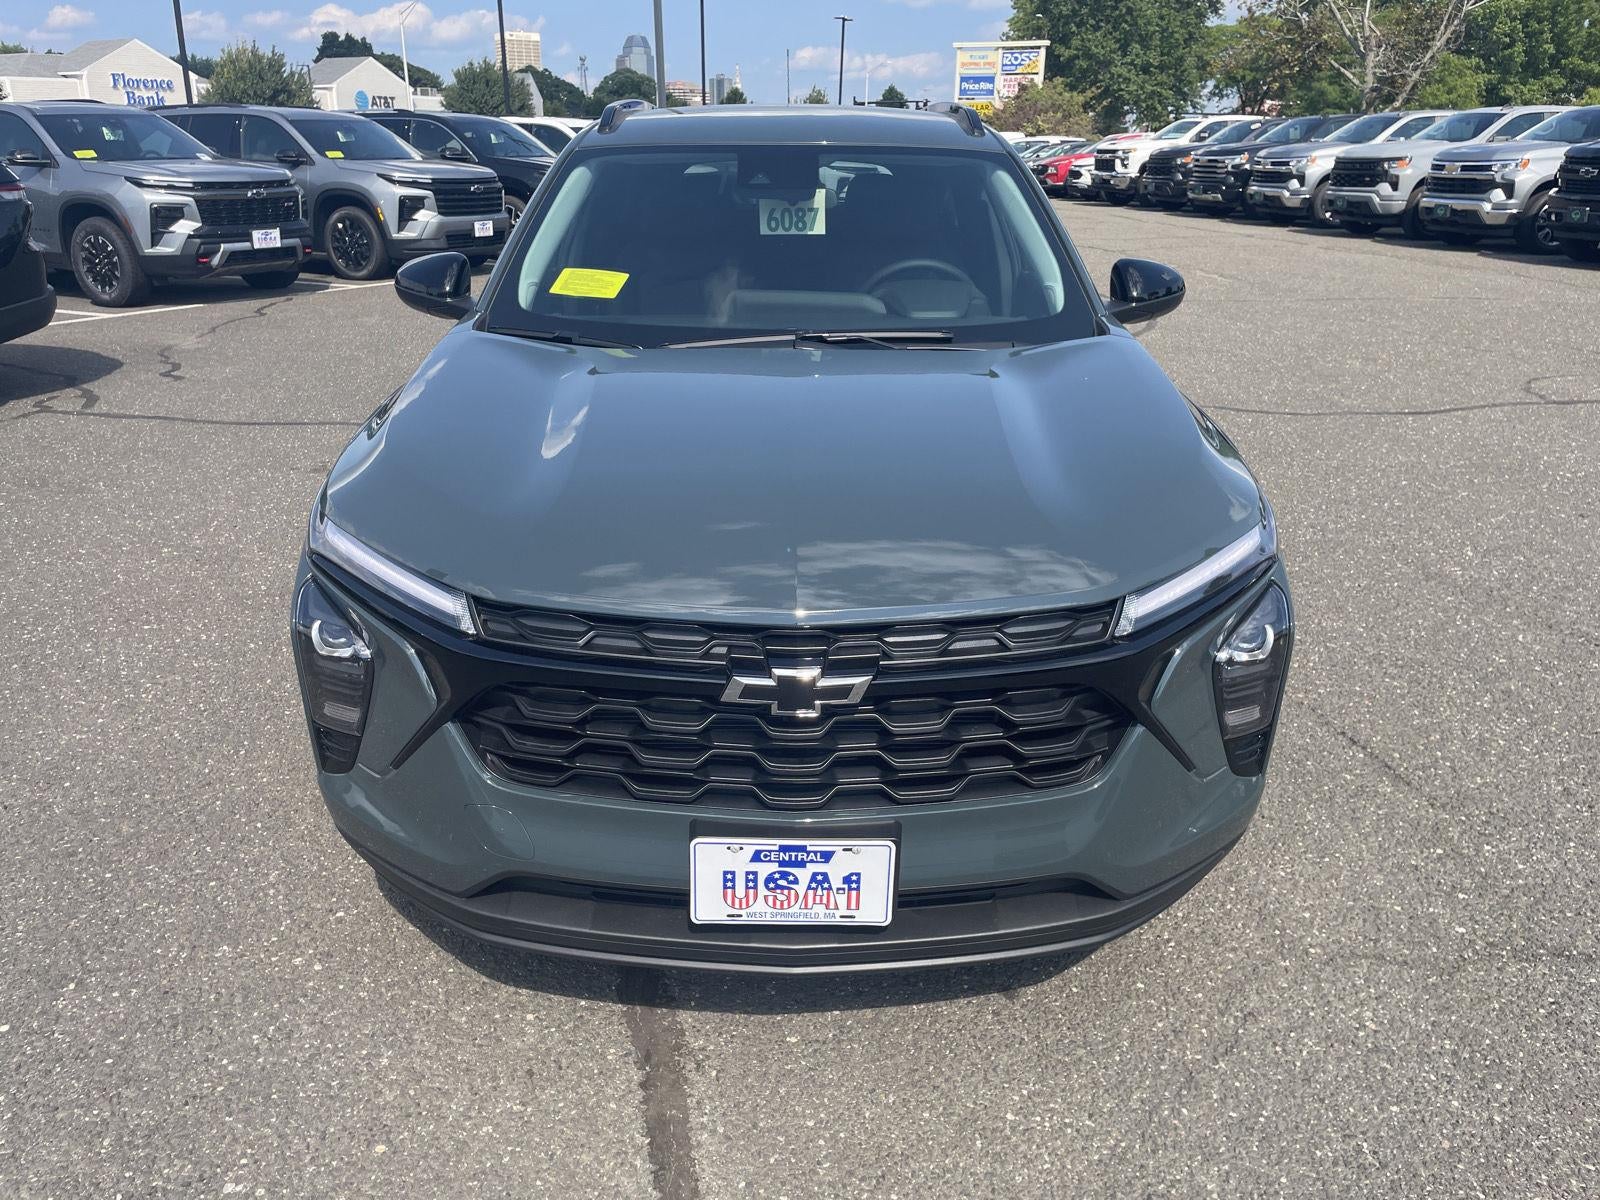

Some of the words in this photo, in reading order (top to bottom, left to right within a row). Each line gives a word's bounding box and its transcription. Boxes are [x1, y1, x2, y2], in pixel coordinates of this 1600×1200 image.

[110, 72, 175, 90] Florence
[125, 90, 165, 105] Bank
[370, 95, 396, 109] AT&T
[766, 207, 820, 232] 6087
[760, 851, 825, 862] CENTRAL
[746, 911, 768, 919] WEST
[769, 911, 822, 920] SPRINGFIELD,
